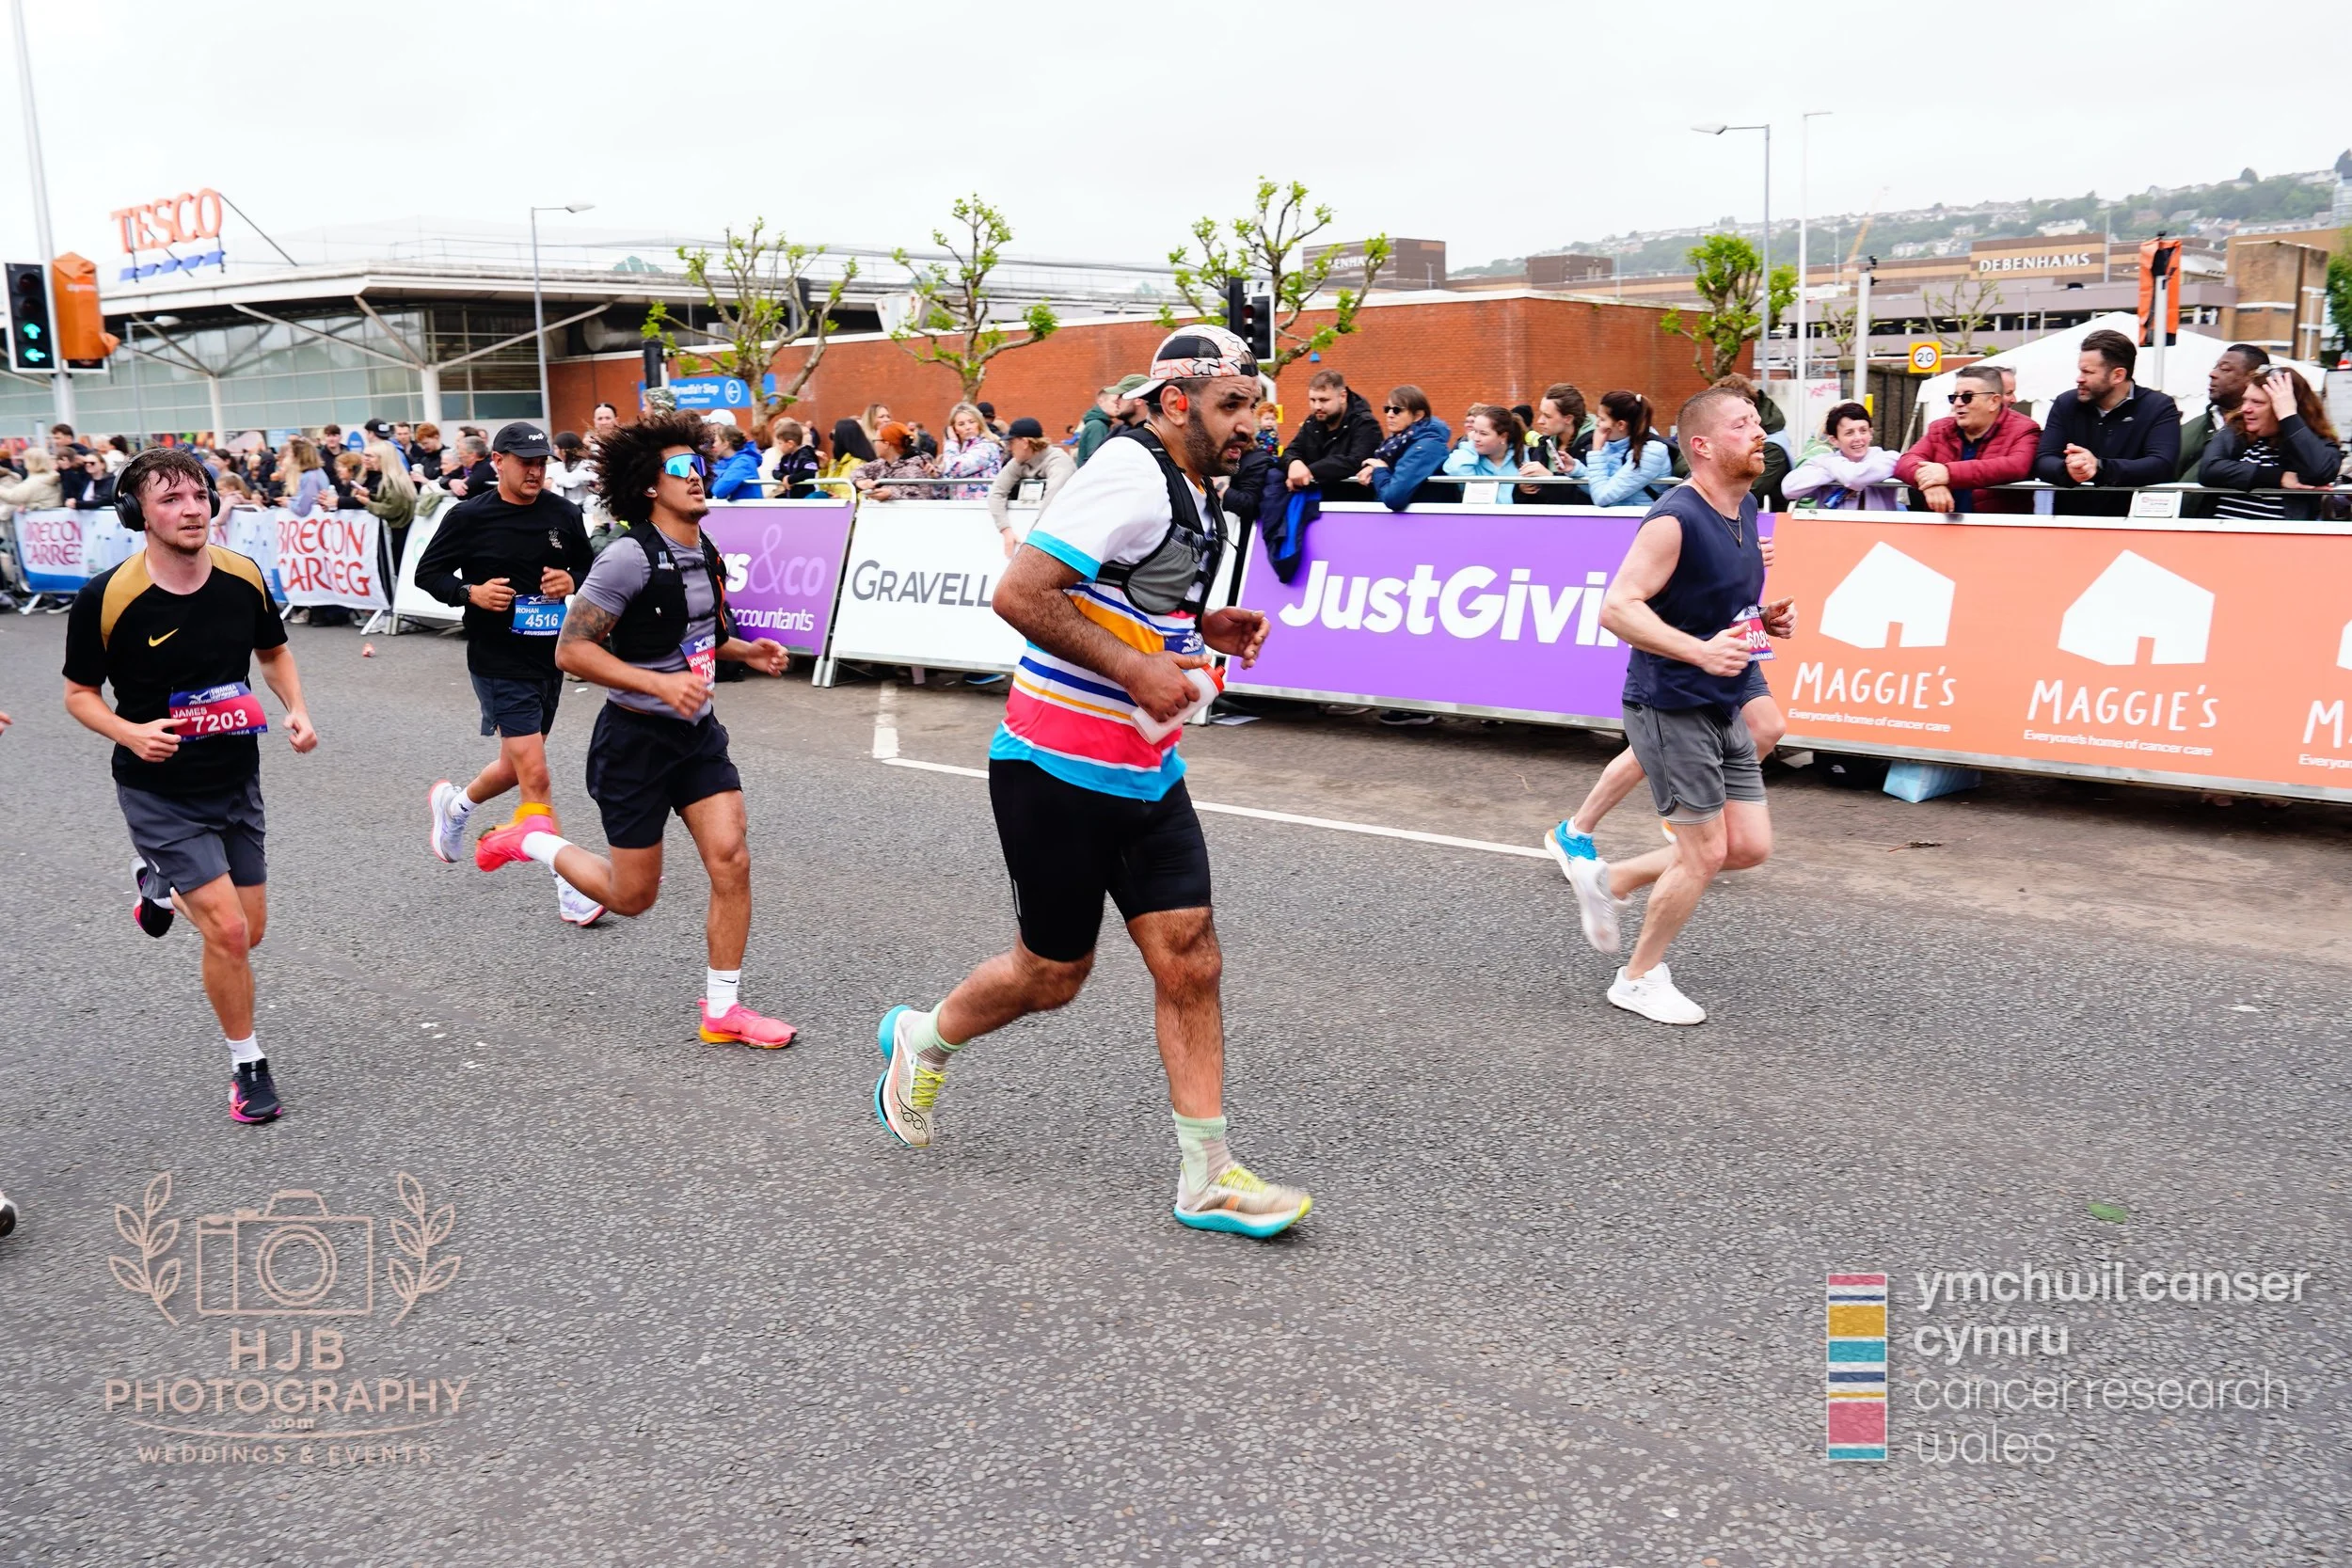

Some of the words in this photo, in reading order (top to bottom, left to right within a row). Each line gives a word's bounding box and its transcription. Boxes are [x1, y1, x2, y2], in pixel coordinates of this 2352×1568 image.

[110, 187, 222, 254] TESCO
[1979, 252, 2090, 273] DEBENHAMS
[1916, 352, 1934, 362] 20
[721, 523, 826, 597] s&co
[1278, 560, 1632, 648] JustGivi
[525, 613, 559, 627] 4516
[1790, 661, 1957, 709] MAGGIE'S
[172, 706, 207, 719] JAMES
[2026, 679, 2219, 731] MAGGIE'S
[191, 708, 248, 733] 7203
[1788, 708, 1843, 722] Everyone's
[1843, 713, 1875, 726] home
[1875, 717, 1887, 726] of
[1887, 719, 1925, 730] cancer
[1926, 722, 1951, 732] care
[2302, 699, 2352, 749] M
[2024, 729, 2087, 744] Everyone's
[2088, 736, 2123, 749] home
[2124, 739, 2138, 750] of
[2138, 741, 2183, 753] cancer
[2183, 745, 2213, 756] care
